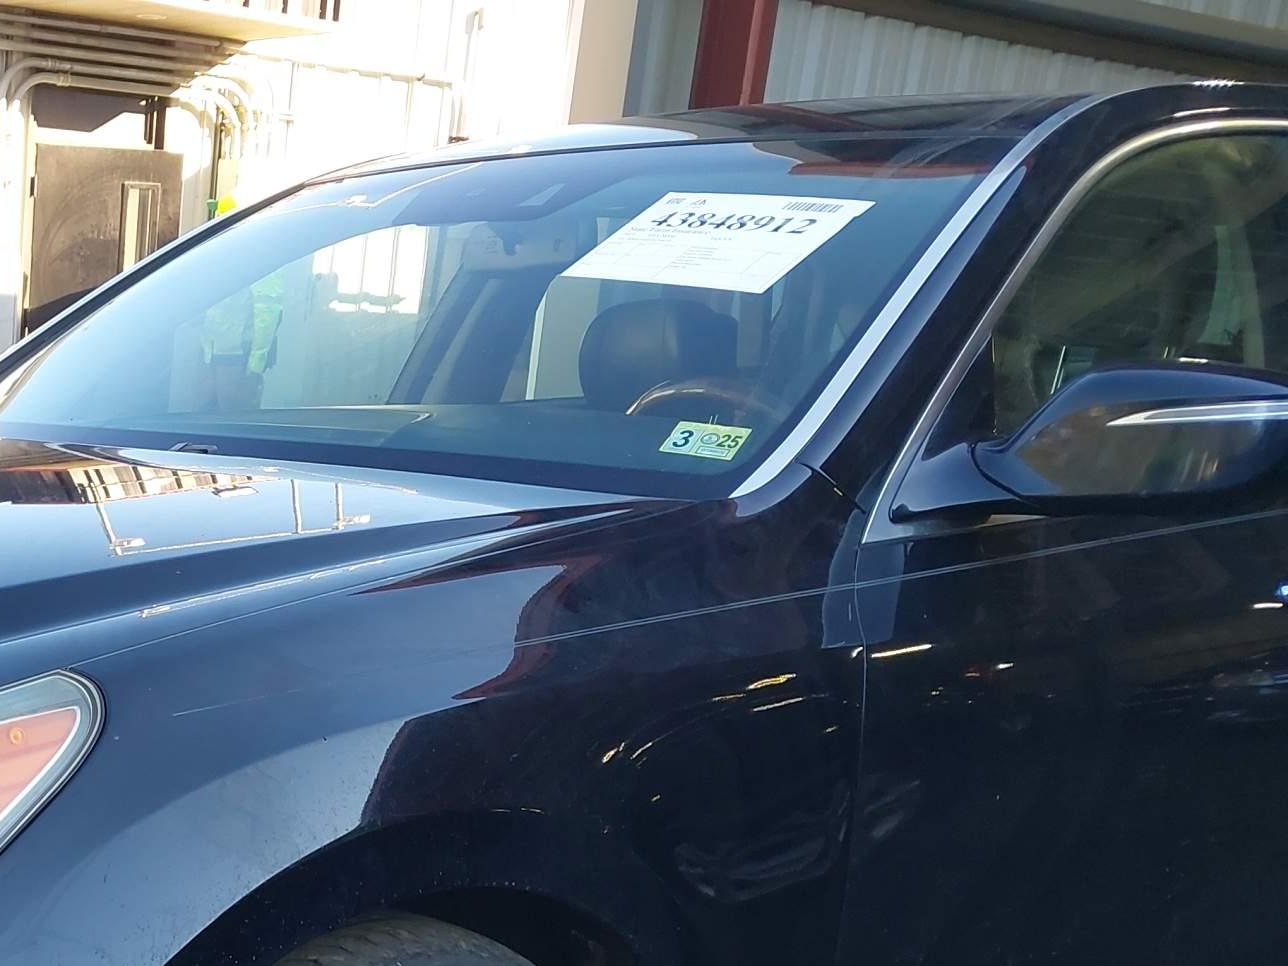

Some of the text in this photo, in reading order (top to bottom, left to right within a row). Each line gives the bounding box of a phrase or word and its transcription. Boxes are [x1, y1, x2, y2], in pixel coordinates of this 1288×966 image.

[651, 211, 818, 234] 43848912
[672, 430, 694, 448] 3
[716, 434, 743, 449] 25
